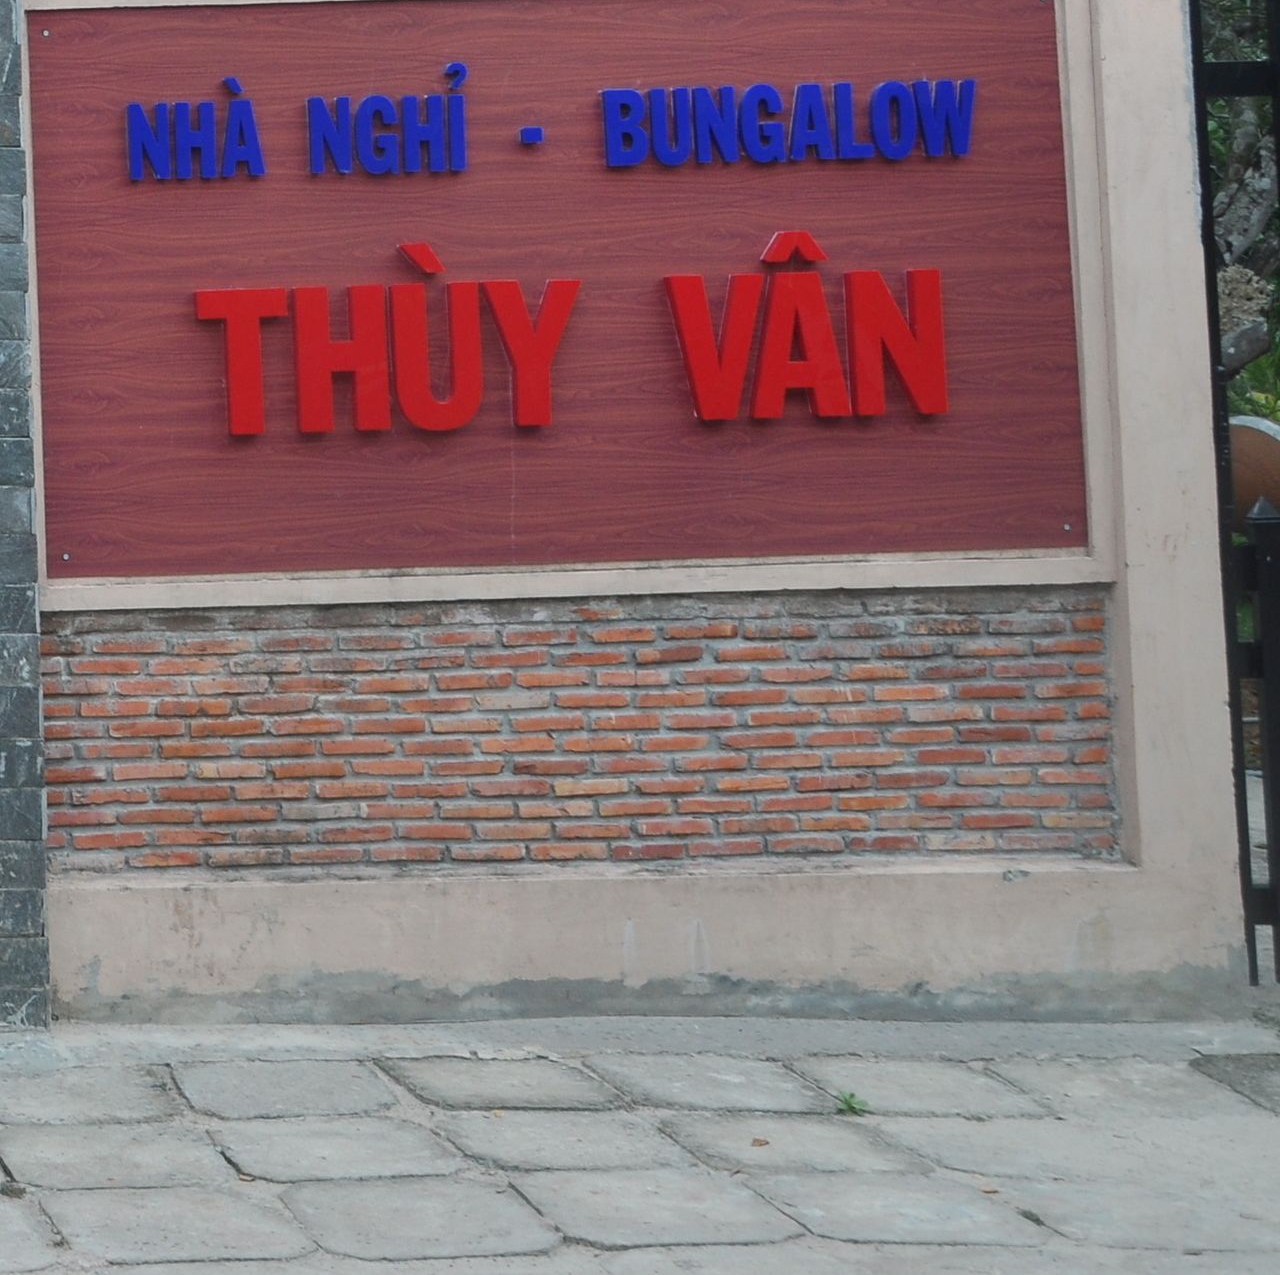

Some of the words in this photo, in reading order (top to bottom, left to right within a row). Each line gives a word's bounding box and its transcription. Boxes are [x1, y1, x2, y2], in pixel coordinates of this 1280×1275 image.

[126, 76, 267, 181] NHÀ
[306, 61, 468, 175] NGHỈ
[600, 78, 977, 168] BUNGALOW
[194, 242, 582, 436] THÙY
[664, 230, 949, 421] VÂN
